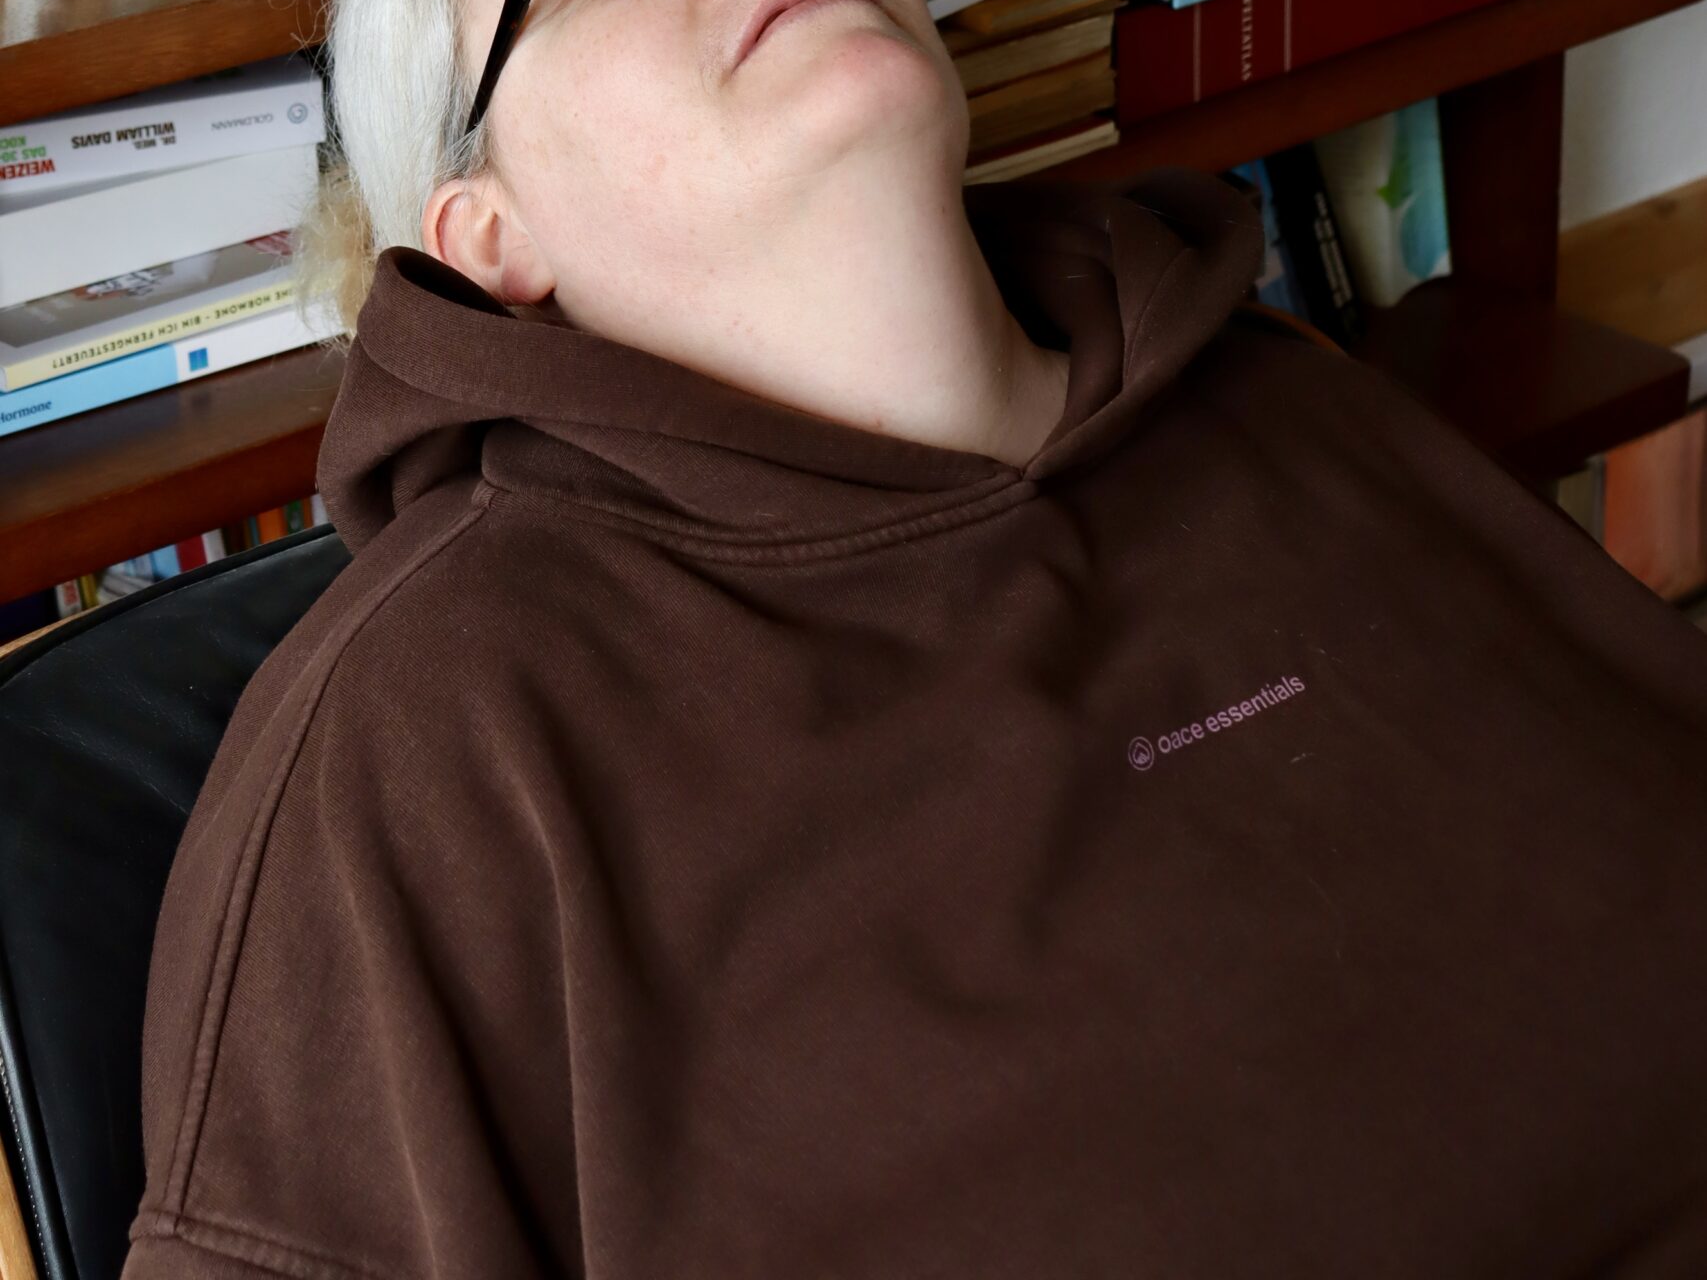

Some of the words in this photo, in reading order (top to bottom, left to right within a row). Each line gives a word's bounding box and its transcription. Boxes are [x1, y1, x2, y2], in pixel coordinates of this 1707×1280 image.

[71, 130, 112, 150] DAVIS
[115, 122, 175, 144] WILLIAM
[215, 292, 272, 320] HORMONE
[158, 320, 179, 338] ICH
[182, 313, 202, 329] BIN
[51, 329, 156, 370] FERNGESTEUERT?
[1157, 722, 1206, 755] oace
[1205, 674, 1307, 734] essentials
